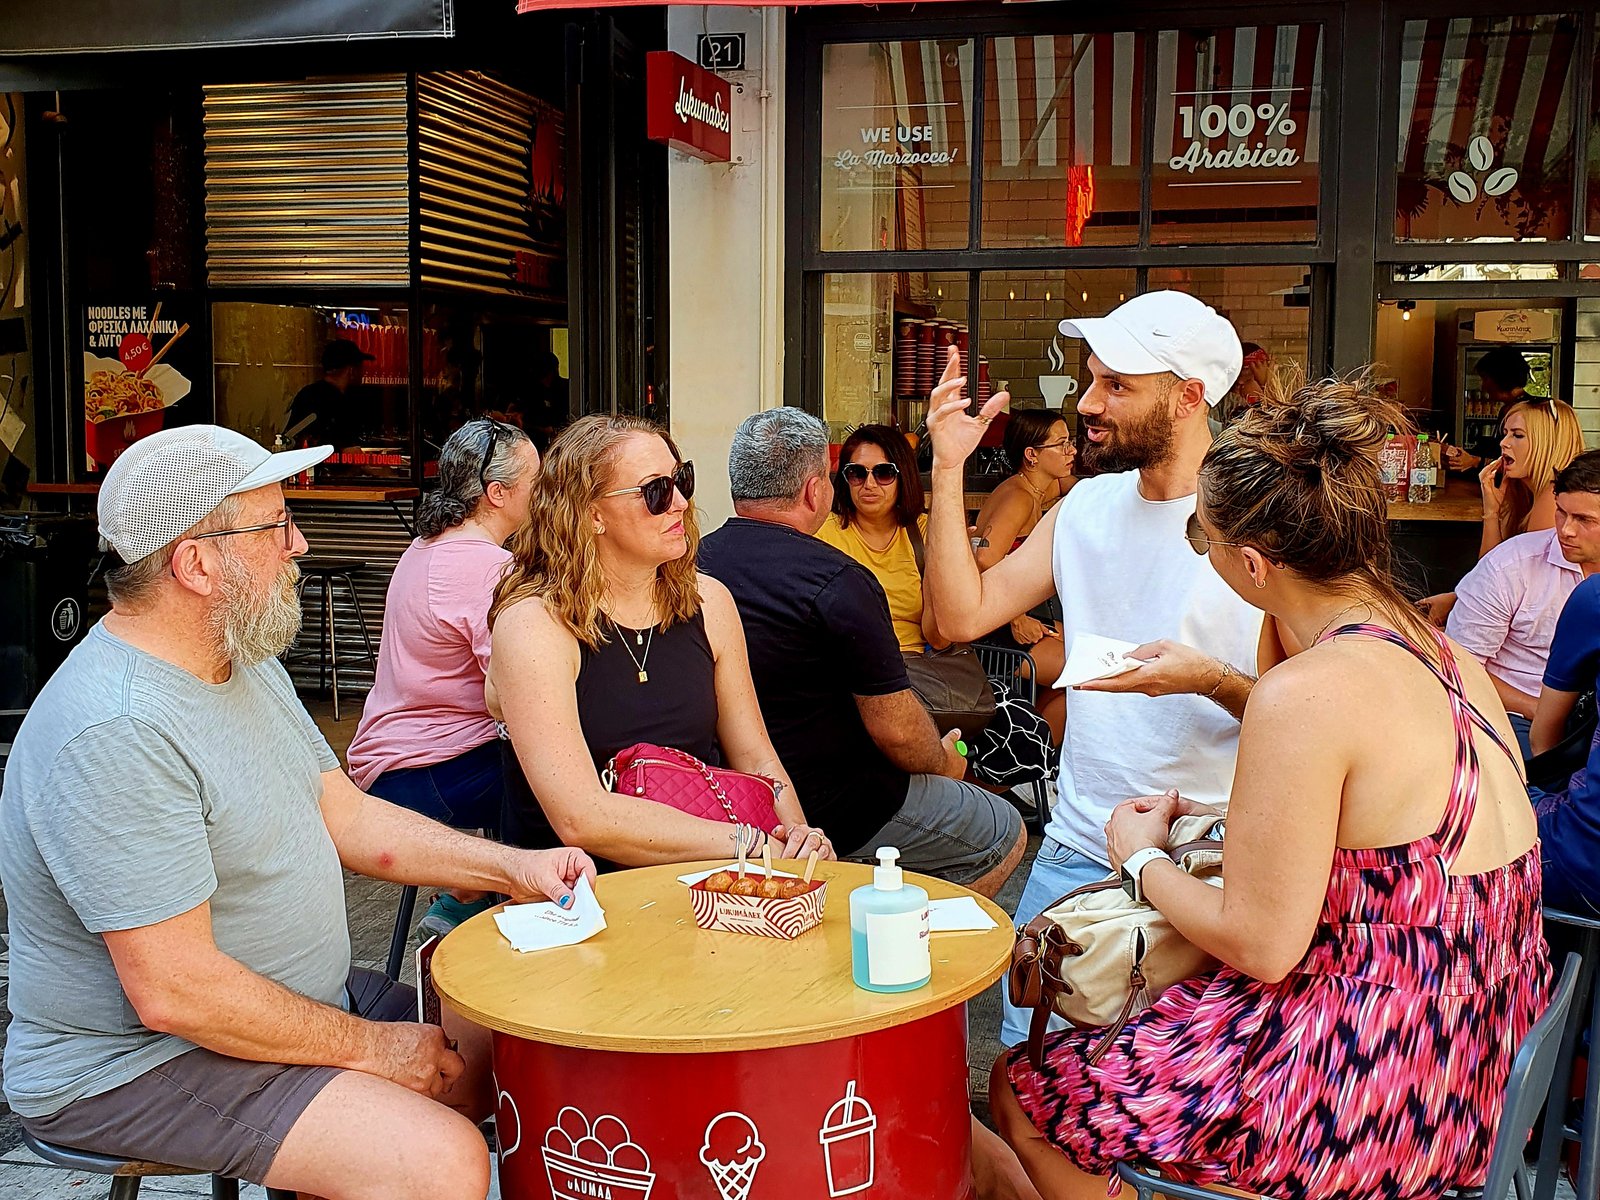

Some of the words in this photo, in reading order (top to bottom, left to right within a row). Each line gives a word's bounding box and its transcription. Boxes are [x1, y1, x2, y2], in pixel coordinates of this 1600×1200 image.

[708, 41, 732, 62] 21
[1179, 102, 1297, 139] 100%
[860, 127, 891, 143] WE
[897, 125, 933, 143] USE
[834, 149, 861, 170] La
[864, 147, 959, 169] Marzocco!
[1169, 140, 1300, 174] Arabica
[88, 306, 131, 319] NOODLES
[88, 320, 128, 333] ΦΡΕΣΚΑ
[130, 320, 179, 333] ΛΑΧΑΝΙΚΑ
[89, 334, 97, 347] &
[98, 334, 123, 347] ΑΥΓΟ
[341, 453, 353, 464] DO
[354, 453, 371, 464] NOT
